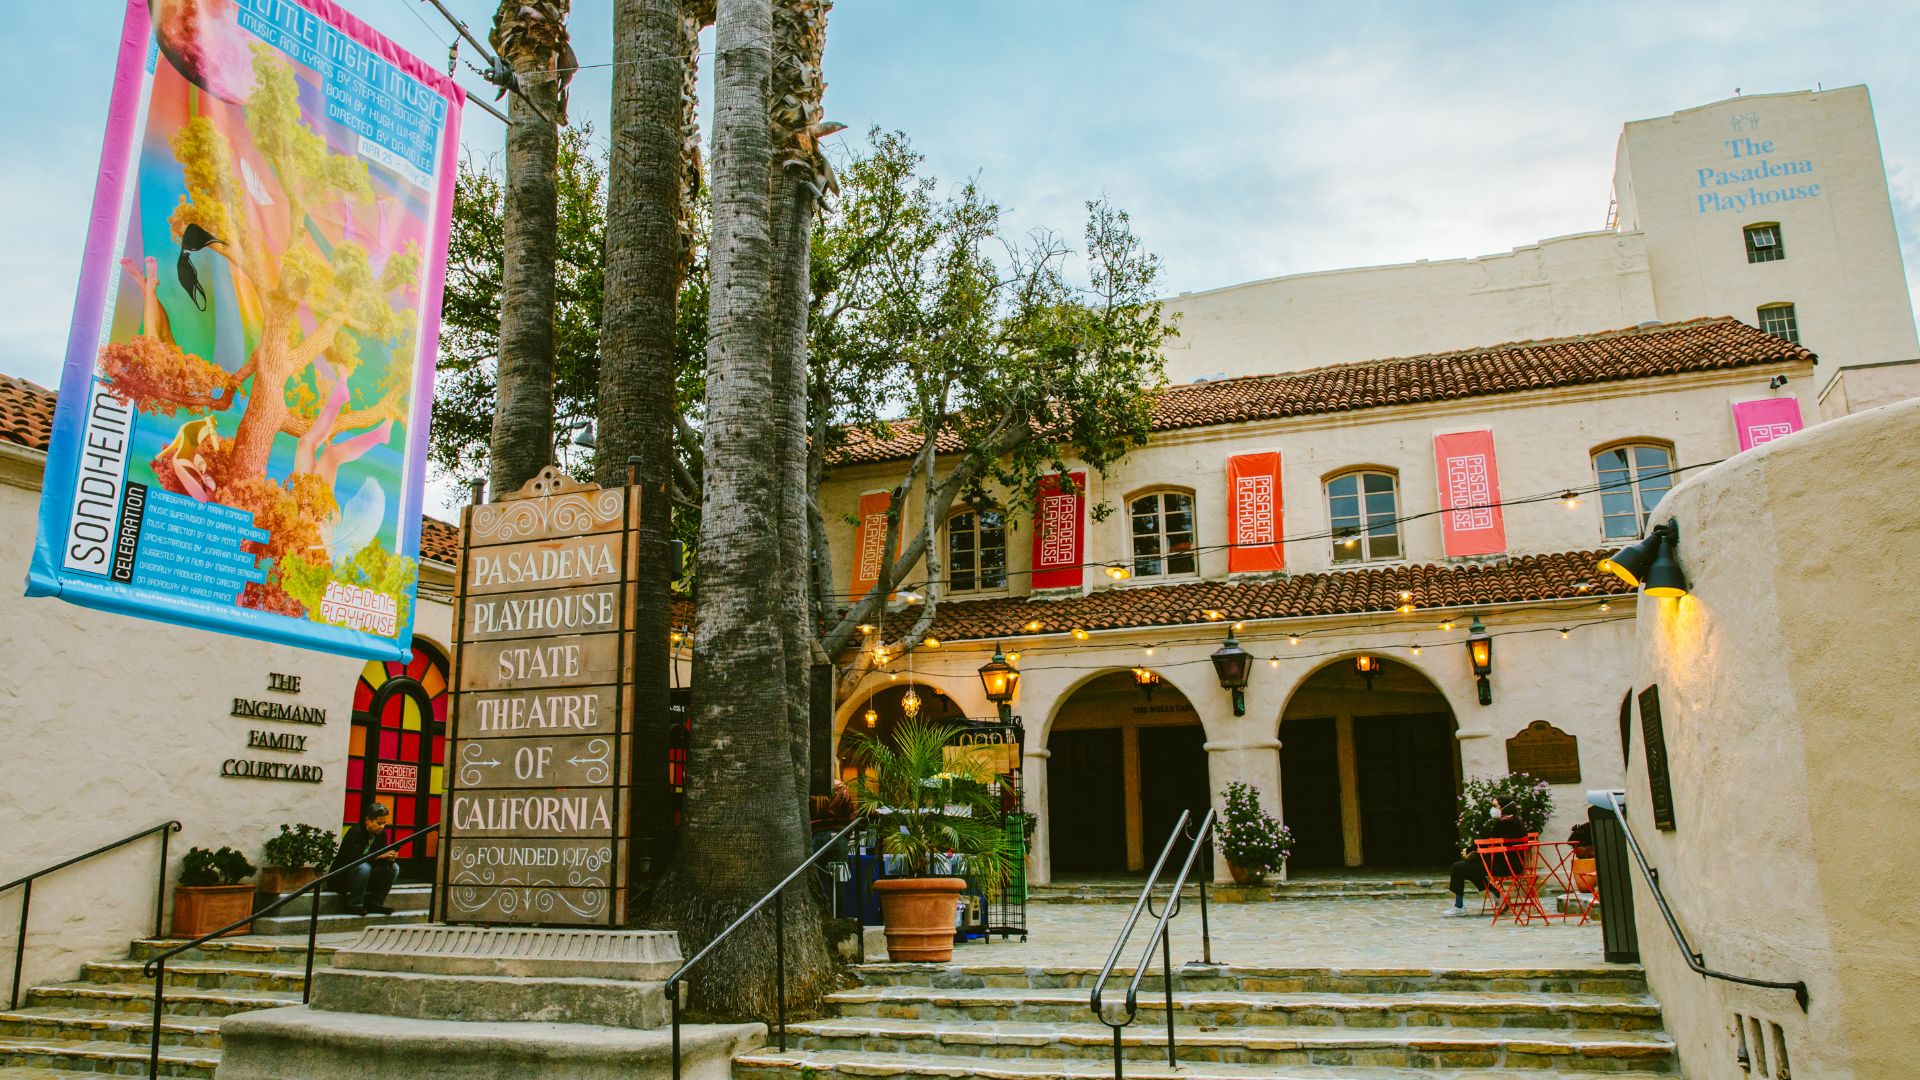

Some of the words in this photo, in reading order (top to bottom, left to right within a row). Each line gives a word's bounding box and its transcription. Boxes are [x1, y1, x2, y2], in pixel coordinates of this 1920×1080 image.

[242, 13, 277, 42] MUSIC
[280, 35, 300, 57] AND
[303, 49, 334, 78] LYRICS
[337, 70, 351, 85] BY
[353, 79, 391, 111] STEPHEN
[393, 103, 434, 138] SONDHEIM
[325, 31, 380, 81] NIGHT
[390, 71, 443, 122] MUSIC
[326, 82, 352, 106] BOOK
[354, 99, 367, 114] BY
[369, 107, 394, 131] HUGH
[397, 123, 433, 155] WHEELER
[329, 103, 373, 137] DIRECTED
[376, 129, 389, 144] BY
[391, 137, 416, 161] DAVID
[416, 154, 432, 173] LEE
[362, 141, 380, 157] APR
[382, 151, 393, 165] 25
[1724, 137, 1775, 159] The
[1696, 159, 1814, 188] Pasadena
[1697, 183, 1821, 214] Playhouse
[70, 392, 128, 565] SONDHEIM
[1450, 459, 1471, 529] PLAYHOUSE
[1468, 457, 1489, 527] PASADENA
[148, 504, 169, 516] MUSIC
[206, 517, 215, 527] BY
[151, 490, 197, 510] CHOREOGRAPHY
[198, 501, 207, 511] BY
[207, 504, 224, 516] MARK
[1239, 479, 1254, 545] PLAYHOUSE
[1256, 477, 1271, 544] PASADENA
[115, 486, 145, 580] CELEBRATION
[146, 518, 166, 530] MUSIC
[167, 522, 196, 537] DIRECTION
[196, 529, 206, 539] BY
[1060, 496, 1074, 562] PASADENA
[142, 546, 175, 562] SUGGESTED
[175, 553, 185, 563] BY
[190, 556, 204, 567] FILM
[204, 559, 214, 569] BY
[143, 532, 193, 551] ORCHESTRATIONS
[193, 543, 202, 552] BY
[202, 545, 232, 560] JONATHAN
[862, 515, 880, 578] PLAYHOUSE
[139, 561, 173, 575] ORIGINALLY
[173, 567, 203, 582] PRODUCED
[202, 573, 216, 584] AND
[216, 575, 241, 590] DIRECTED
[471, 543, 617, 588] PASADENA
[136, 575, 146, 585] ON
[147, 577, 181, 591] BROADWAY
[181, 583, 190, 593] BY
[190, 585, 212, 598] HAROLD
[213, 589, 233, 602] PRINCE
[326, 582, 396, 613] PASADENA
[321, 604, 393, 634] PLAYHOUSE
[472, 591, 615, 635] PLAYHOUSE
[498, 644, 581, 681] STATE
[267, 672, 301, 693] THE
[231, 697, 327, 725] ENGEMANN
[476, 694, 599, 732] THEATRE
[247, 729, 308, 752] FAMILY
[221, 758, 324, 784] COURTYARD
[378, 765, 416, 778] PASADENA
[514, 746, 554, 780] OF
[377, 777, 415, 790] PLAYHOUSE
[453, 795, 612, 833] CALIFORNIA
[477, 846, 559, 867] FOUNDED
[562, 847, 588, 870] 1917
